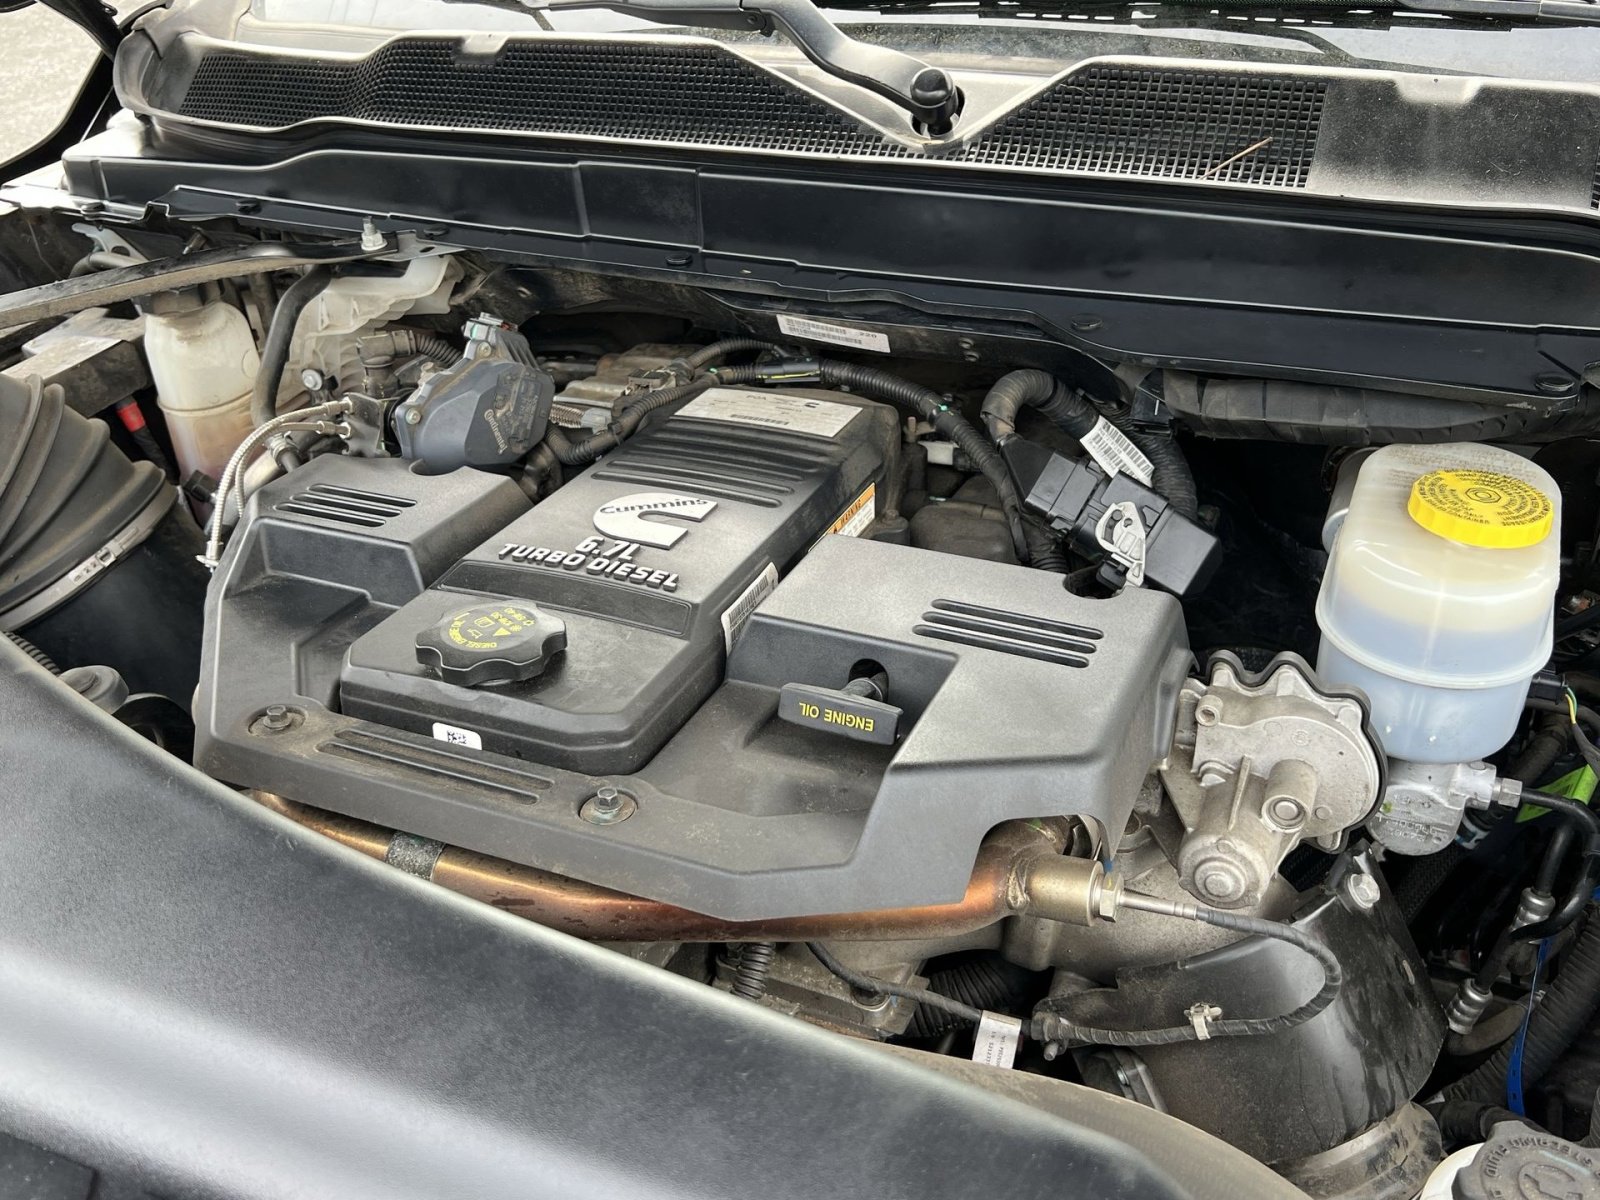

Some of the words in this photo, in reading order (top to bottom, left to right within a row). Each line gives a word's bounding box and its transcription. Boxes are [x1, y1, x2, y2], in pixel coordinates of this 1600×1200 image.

[484, 408, 508, 455] Continental
[599, 497, 708, 515] Cummins
[575, 535, 641, 563] 6.7L
[498, 543, 586, 571] TURBO
[586, 557, 680, 592] DIESEL
[798, 701, 820, 719] OIL
[823, 708, 875, 732] ENGINE
